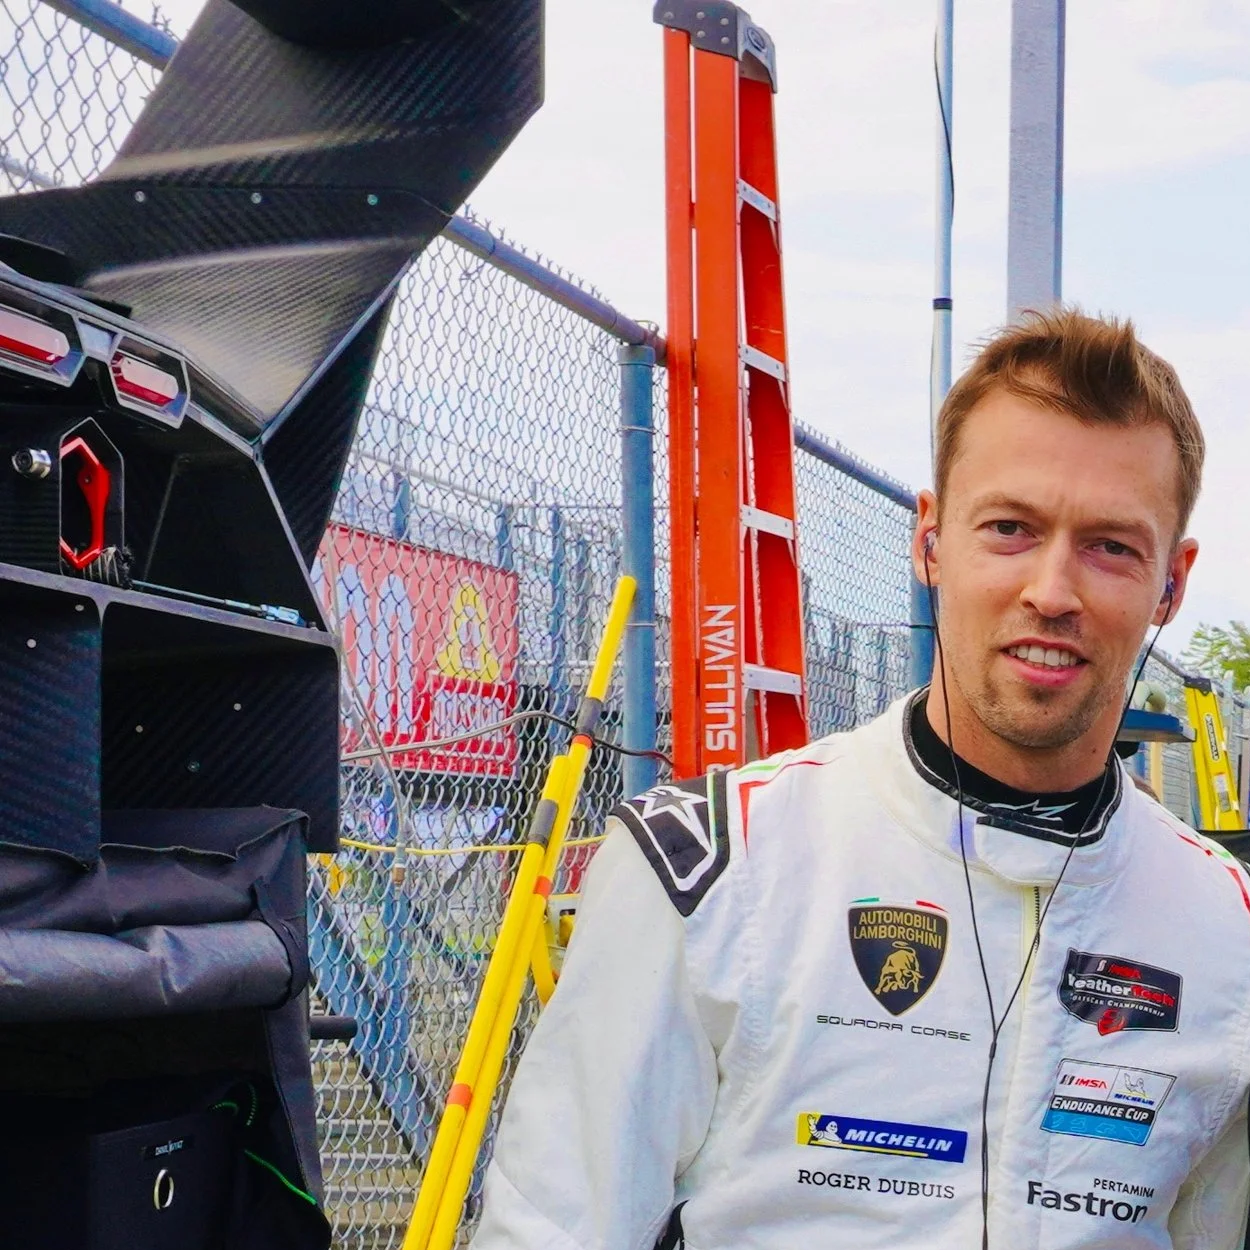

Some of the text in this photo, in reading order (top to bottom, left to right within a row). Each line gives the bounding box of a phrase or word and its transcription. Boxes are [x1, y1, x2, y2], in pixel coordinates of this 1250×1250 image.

[702, 604, 737, 751] SULLIVAN
[858, 910, 938, 933] AUTOMOBILI
[853, 925, 942, 949] LAMBORGHINI
[816, 1014, 972, 1042] SQUADRA CORSE
[1075, 1077, 1108, 1090] IMSA
[1051, 1097, 1149, 1122] ENDURANCE CUP
[844, 1128, 953, 1152] MICHELIN
[797, 1169, 955, 1199] ROGER DUBUIS
[1026, 1180, 1148, 1224] Fastron
